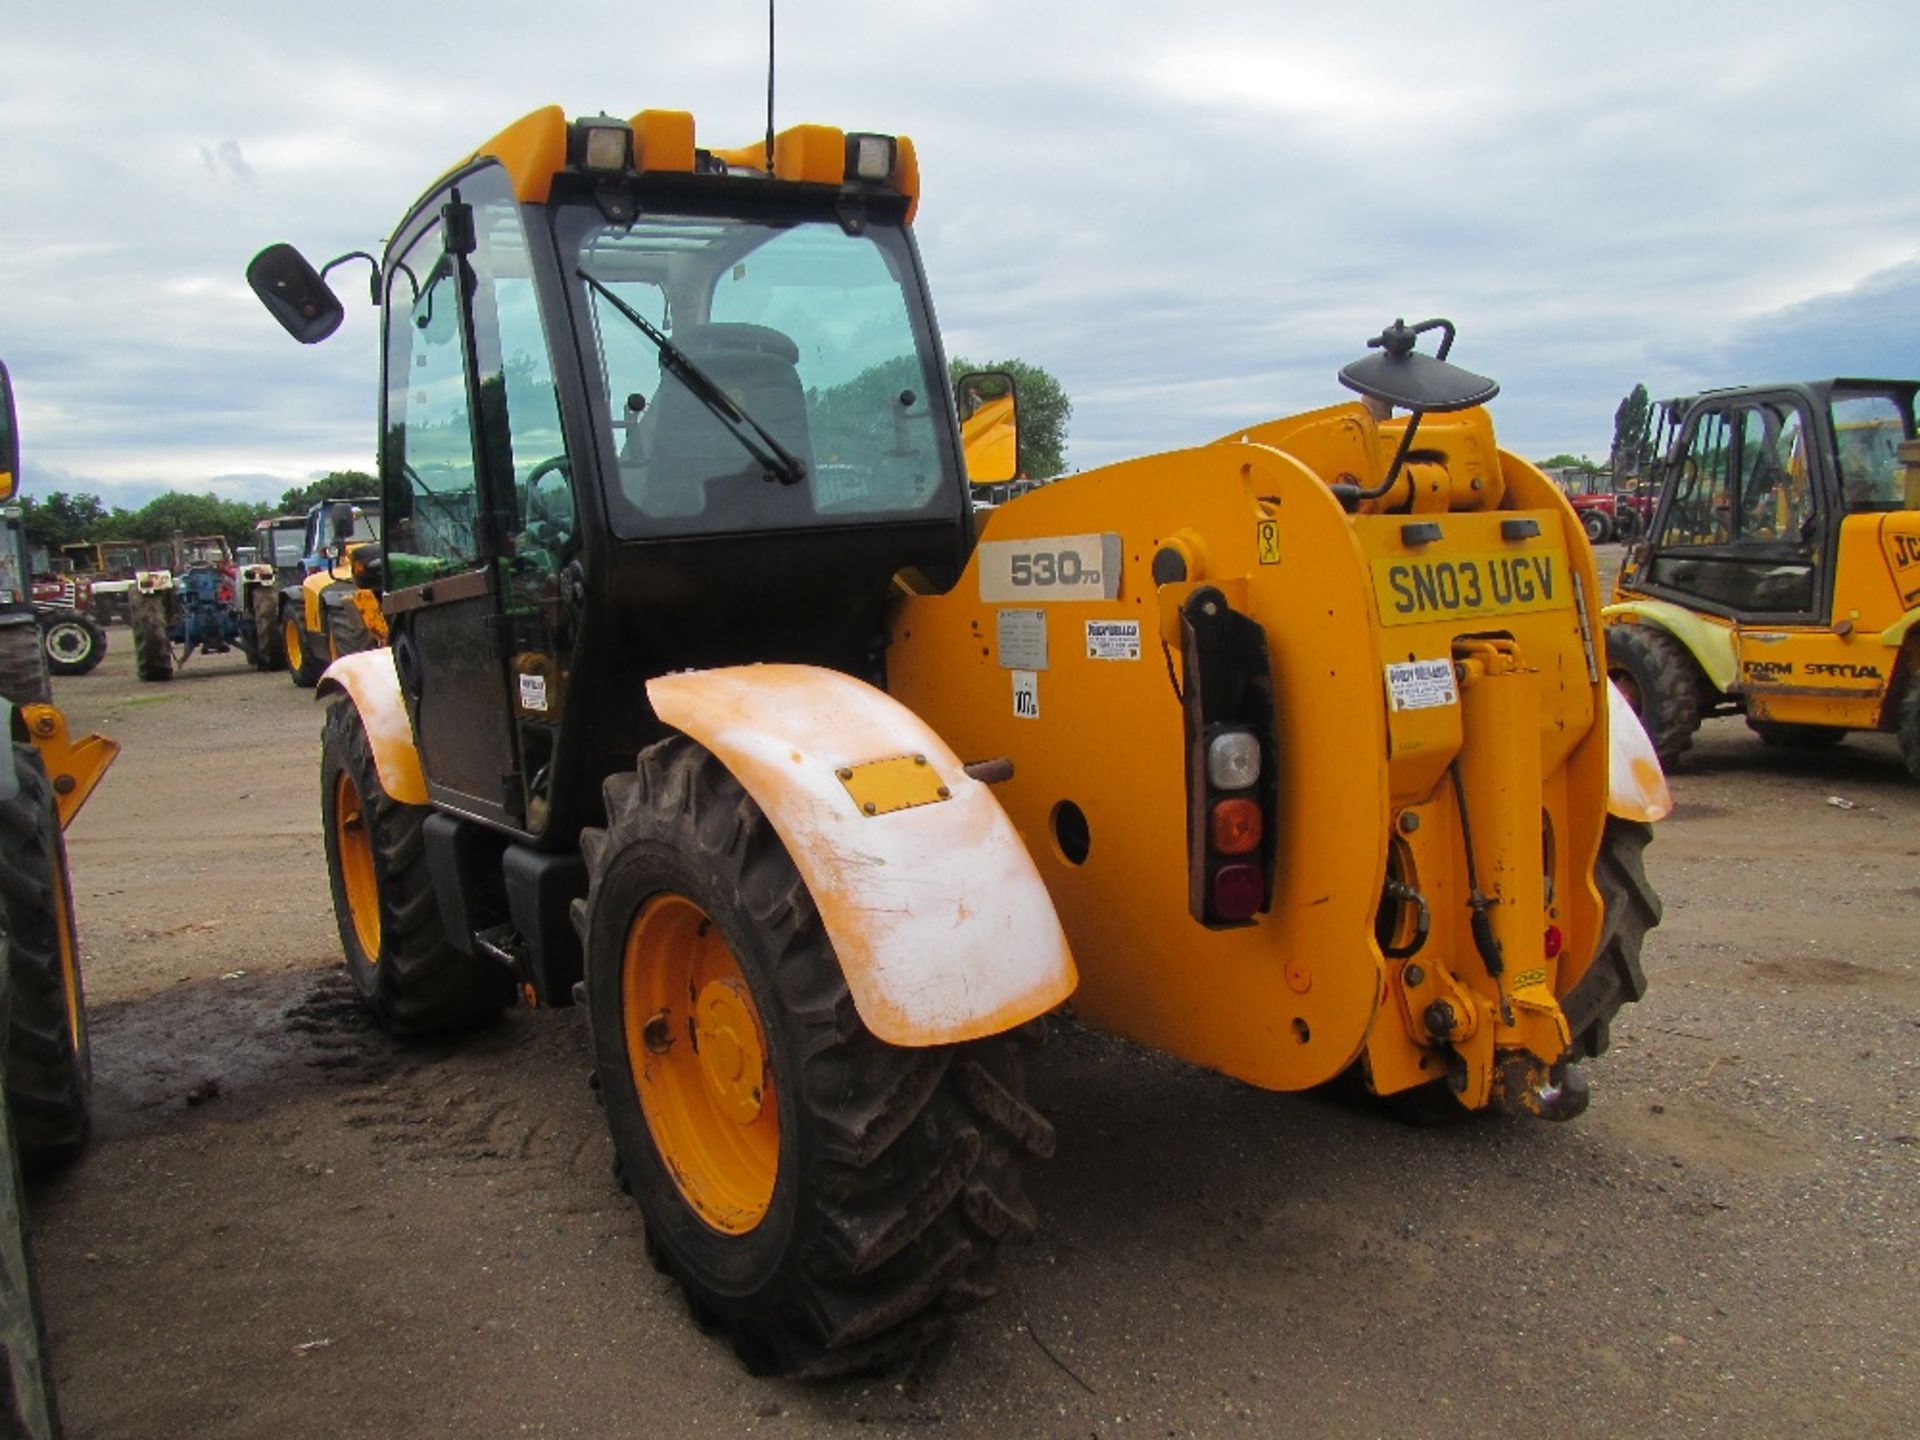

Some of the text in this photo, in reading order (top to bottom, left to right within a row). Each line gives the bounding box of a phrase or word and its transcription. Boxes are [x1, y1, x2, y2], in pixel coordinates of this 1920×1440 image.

[1893, 535, 1920, 566] JC
[1388, 556, 1553, 613] SN03 UGV
[1743, 661, 1882, 679] FARM SPECIAL
